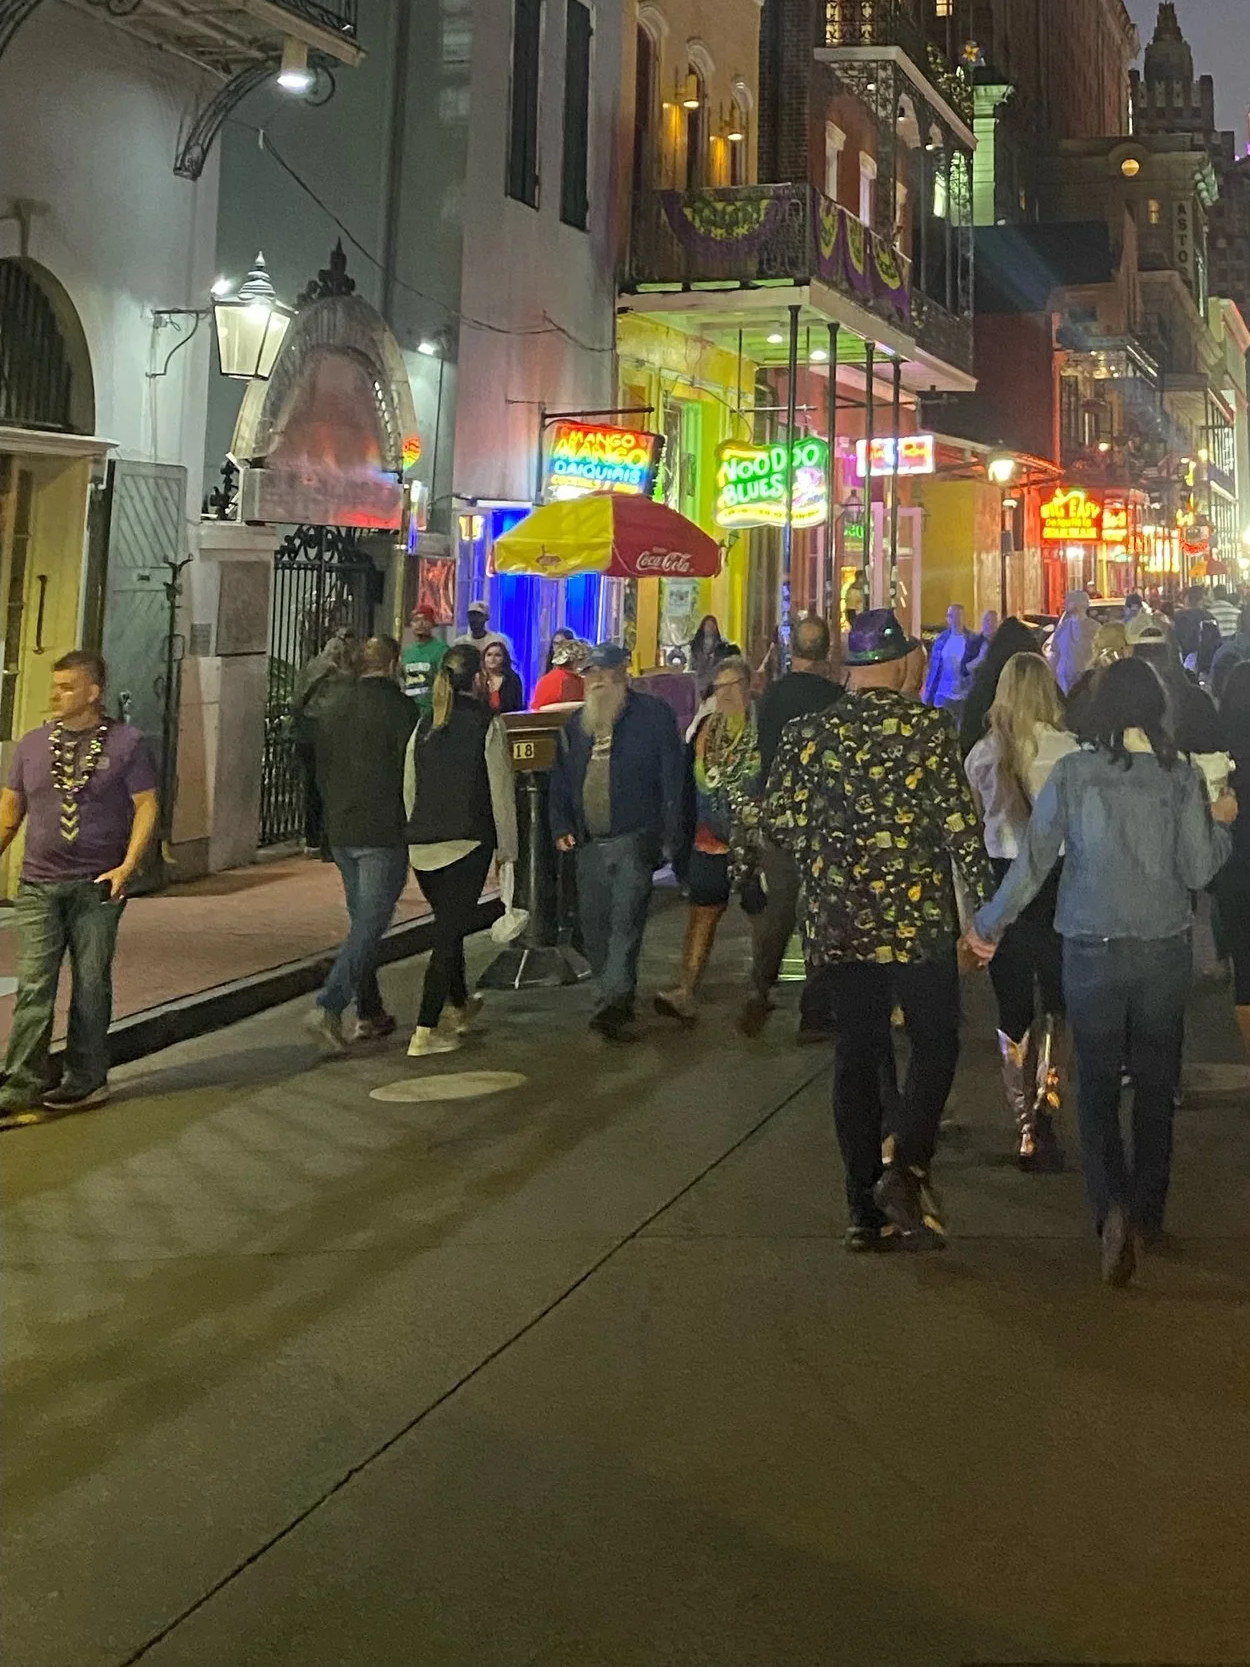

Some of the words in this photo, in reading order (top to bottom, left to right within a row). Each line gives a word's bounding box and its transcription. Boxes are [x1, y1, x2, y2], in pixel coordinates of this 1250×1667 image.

[569, 430, 636, 448] MANGO
[553, 438, 650, 468] MANGO
[723, 444, 819, 481] VOODOO
[554, 460, 641, 484] DAIQUIRIS
[722, 473, 784, 506] BLUES
[515, 744, 533, 757] 18
